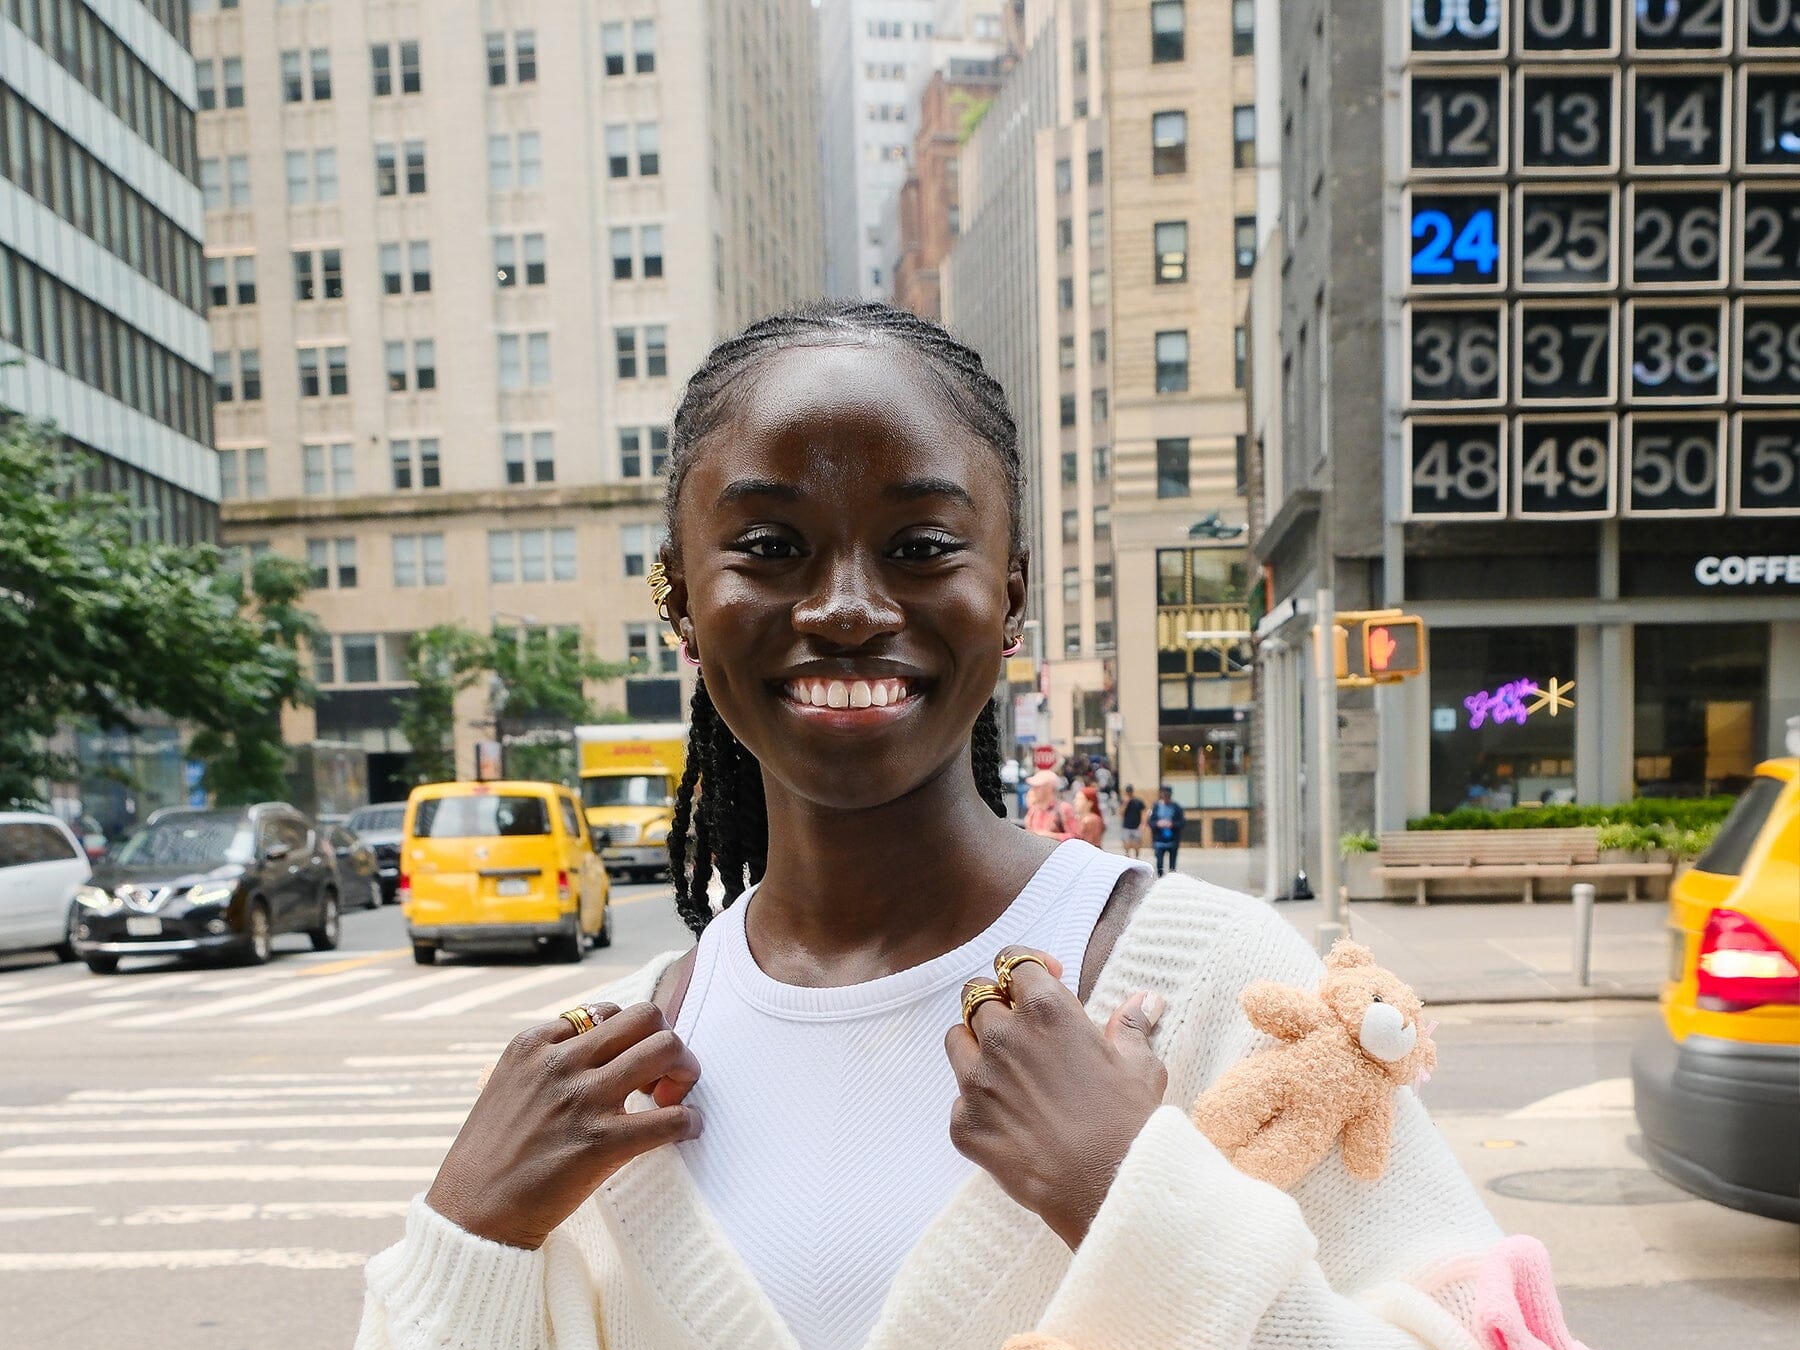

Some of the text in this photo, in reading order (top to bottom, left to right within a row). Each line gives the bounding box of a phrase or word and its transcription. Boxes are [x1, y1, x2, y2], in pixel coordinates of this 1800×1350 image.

[1412, 0, 1499, 39] 00
[1750, 0, 1800, 36] 0
[1421, 92, 1490, 155] 12
[1534, 92, 1599, 155] 13
[1645, 92, 1711, 154] 14
[1411, 206, 1800, 274] 24 25 26 2
[1414, 324, 1497, 386] 36
[1524, 324, 1608, 385] 37
[1633, 322, 1718, 386] 38
[1413, 440, 1497, 500] 48
[1524, 438, 1607, 497] 49
[1632, 436, 1715, 497] 50
